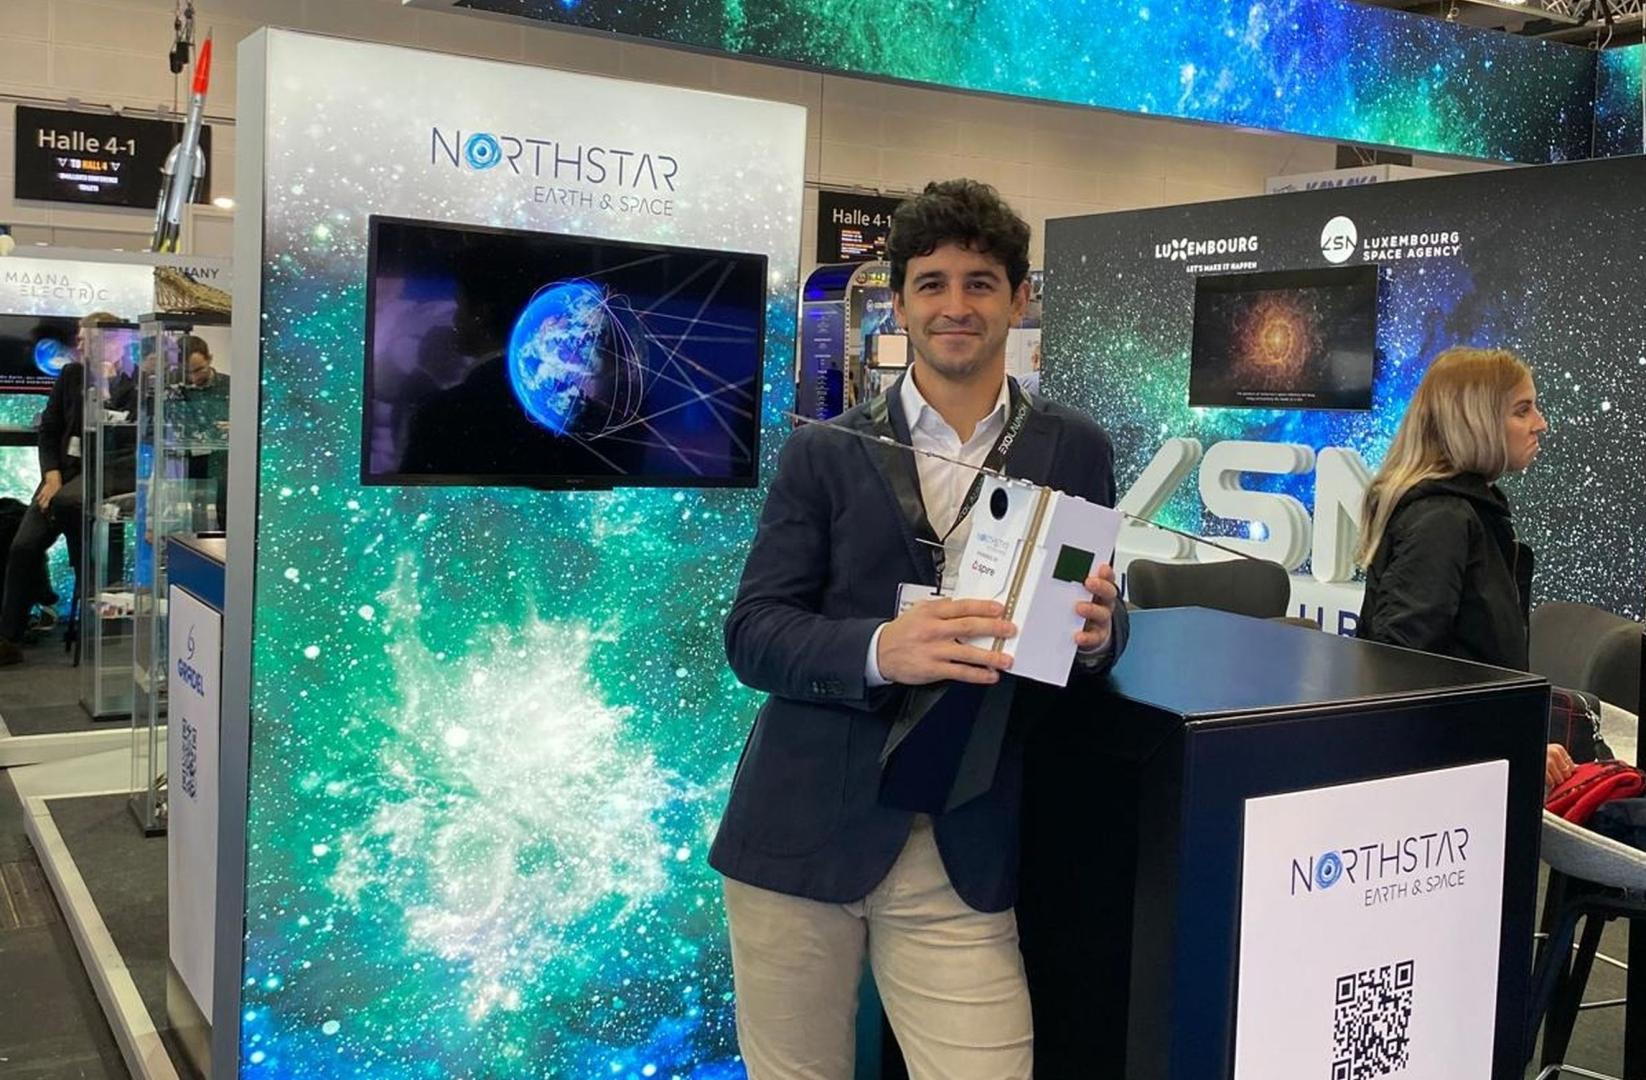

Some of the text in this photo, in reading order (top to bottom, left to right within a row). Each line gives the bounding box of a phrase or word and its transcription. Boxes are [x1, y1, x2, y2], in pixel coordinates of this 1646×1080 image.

[38, 128, 136, 156] Halle 4-1
[431, 126, 678, 192] NORTHSTAR
[534, 186, 673, 216] EARTH & SPACE
[832, 208, 892, 228] Halle 4-1
[1154, 236, 1259, 261] LUXEMBOURG
[1363, 231, 1460, 249] LUXEMBOURG
[1363, 245, 1460, 261] SPACE AGENCY
[5, 271, 70, 287] MAANA
[1186, 264, 1203, 273] LET'S
[1204, 263, 1222, 272] MAKE
[1223, 262, 1230, 271] IT
[1291, 827, 1470, 896] NORTHSTAR
[1364, 869, 1466, 907] EARTH & SPACE
